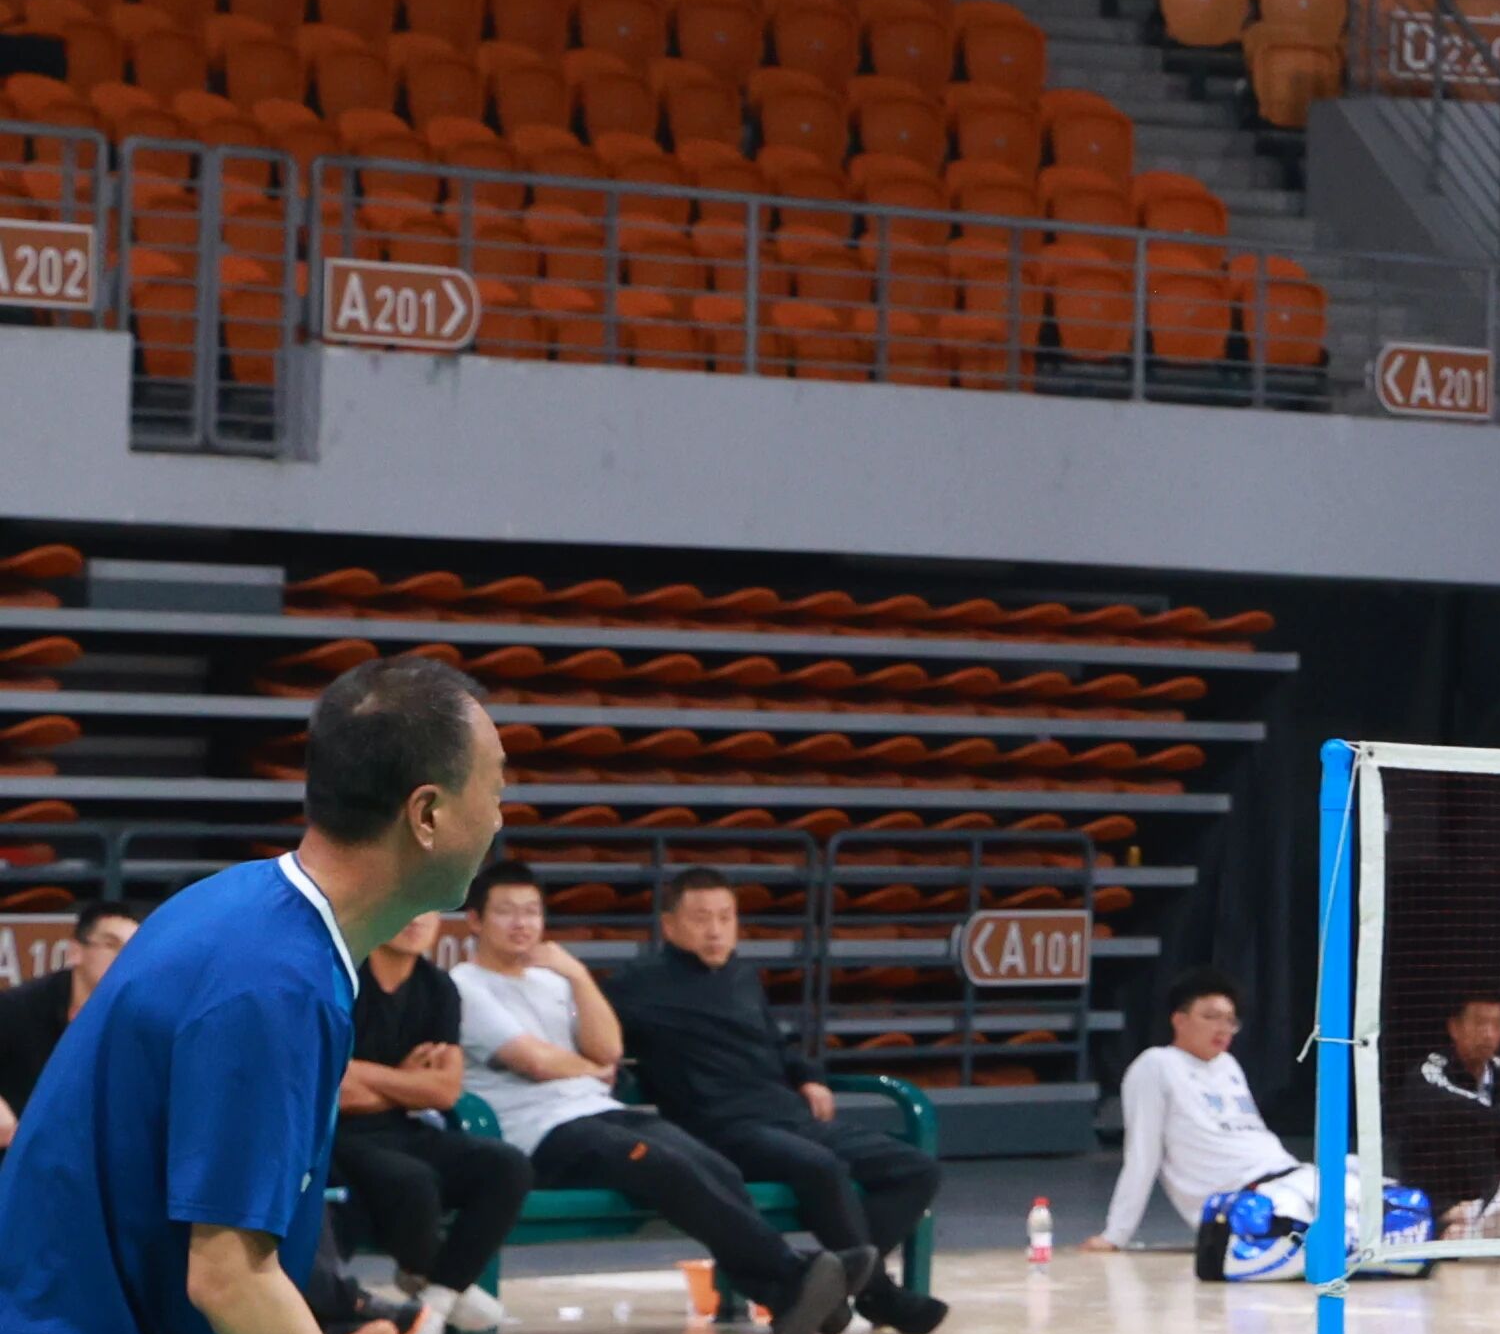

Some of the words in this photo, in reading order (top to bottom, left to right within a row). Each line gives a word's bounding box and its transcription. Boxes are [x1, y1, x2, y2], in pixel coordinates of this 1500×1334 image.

[337, 272, 438, 336] A201
[1410, 356, 1488, 409] A201
[1000, 923, 1082, 976] A101
